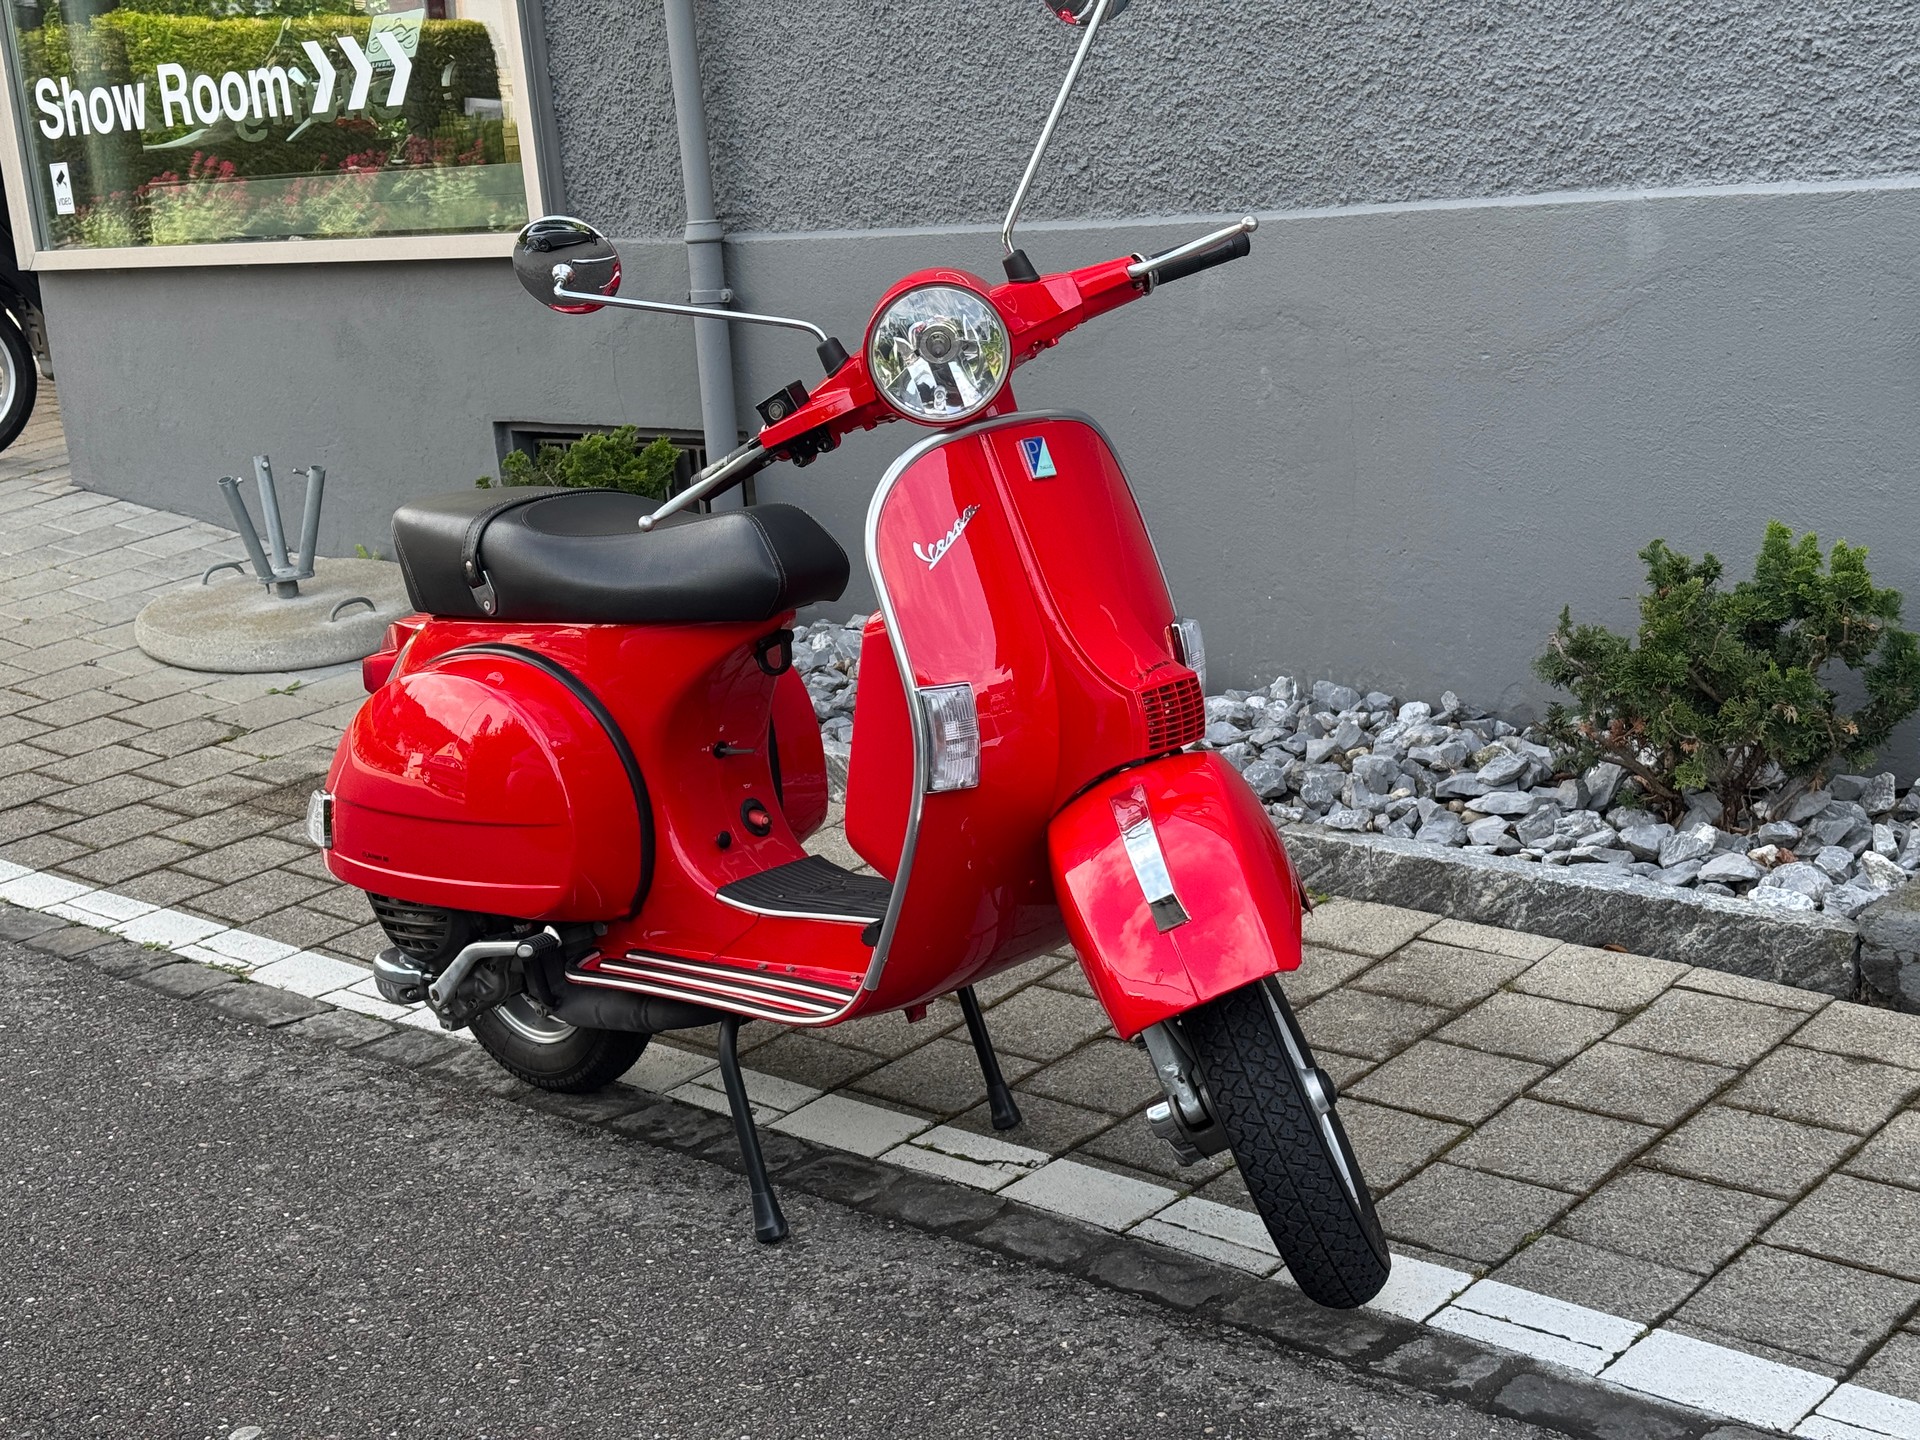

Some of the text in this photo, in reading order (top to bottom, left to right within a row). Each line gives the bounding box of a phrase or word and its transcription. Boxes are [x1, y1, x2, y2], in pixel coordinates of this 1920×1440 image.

[35, 77, 145, 140] Show
[157, 62, 293, 127] Room
[912, 504, 981, 571] Vespa
